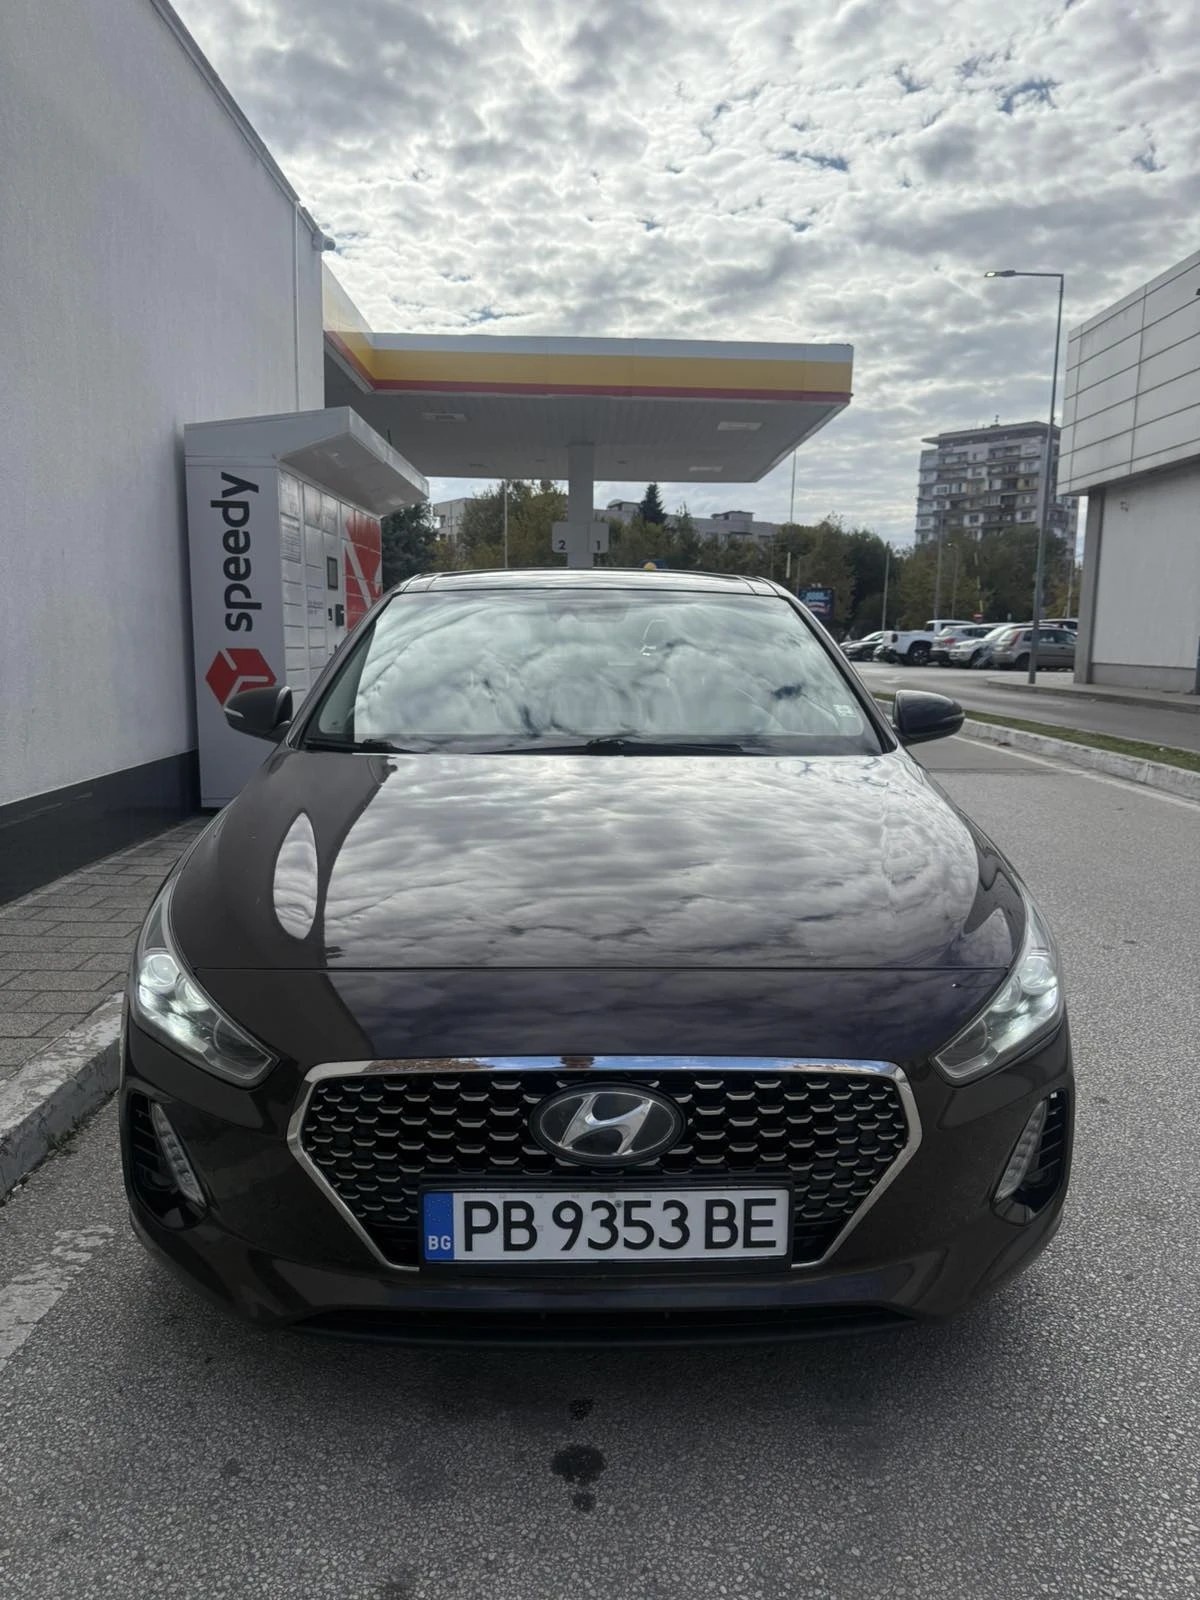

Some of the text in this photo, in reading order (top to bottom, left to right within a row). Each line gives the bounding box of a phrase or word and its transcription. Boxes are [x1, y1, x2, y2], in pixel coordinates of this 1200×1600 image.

[210, 471, 262, 632] speedy
[558, 540, 566, 550] 2
[463, 1198, 777, 1252] PB 9353 BE
[428, 1235, 451, 1250] BG
